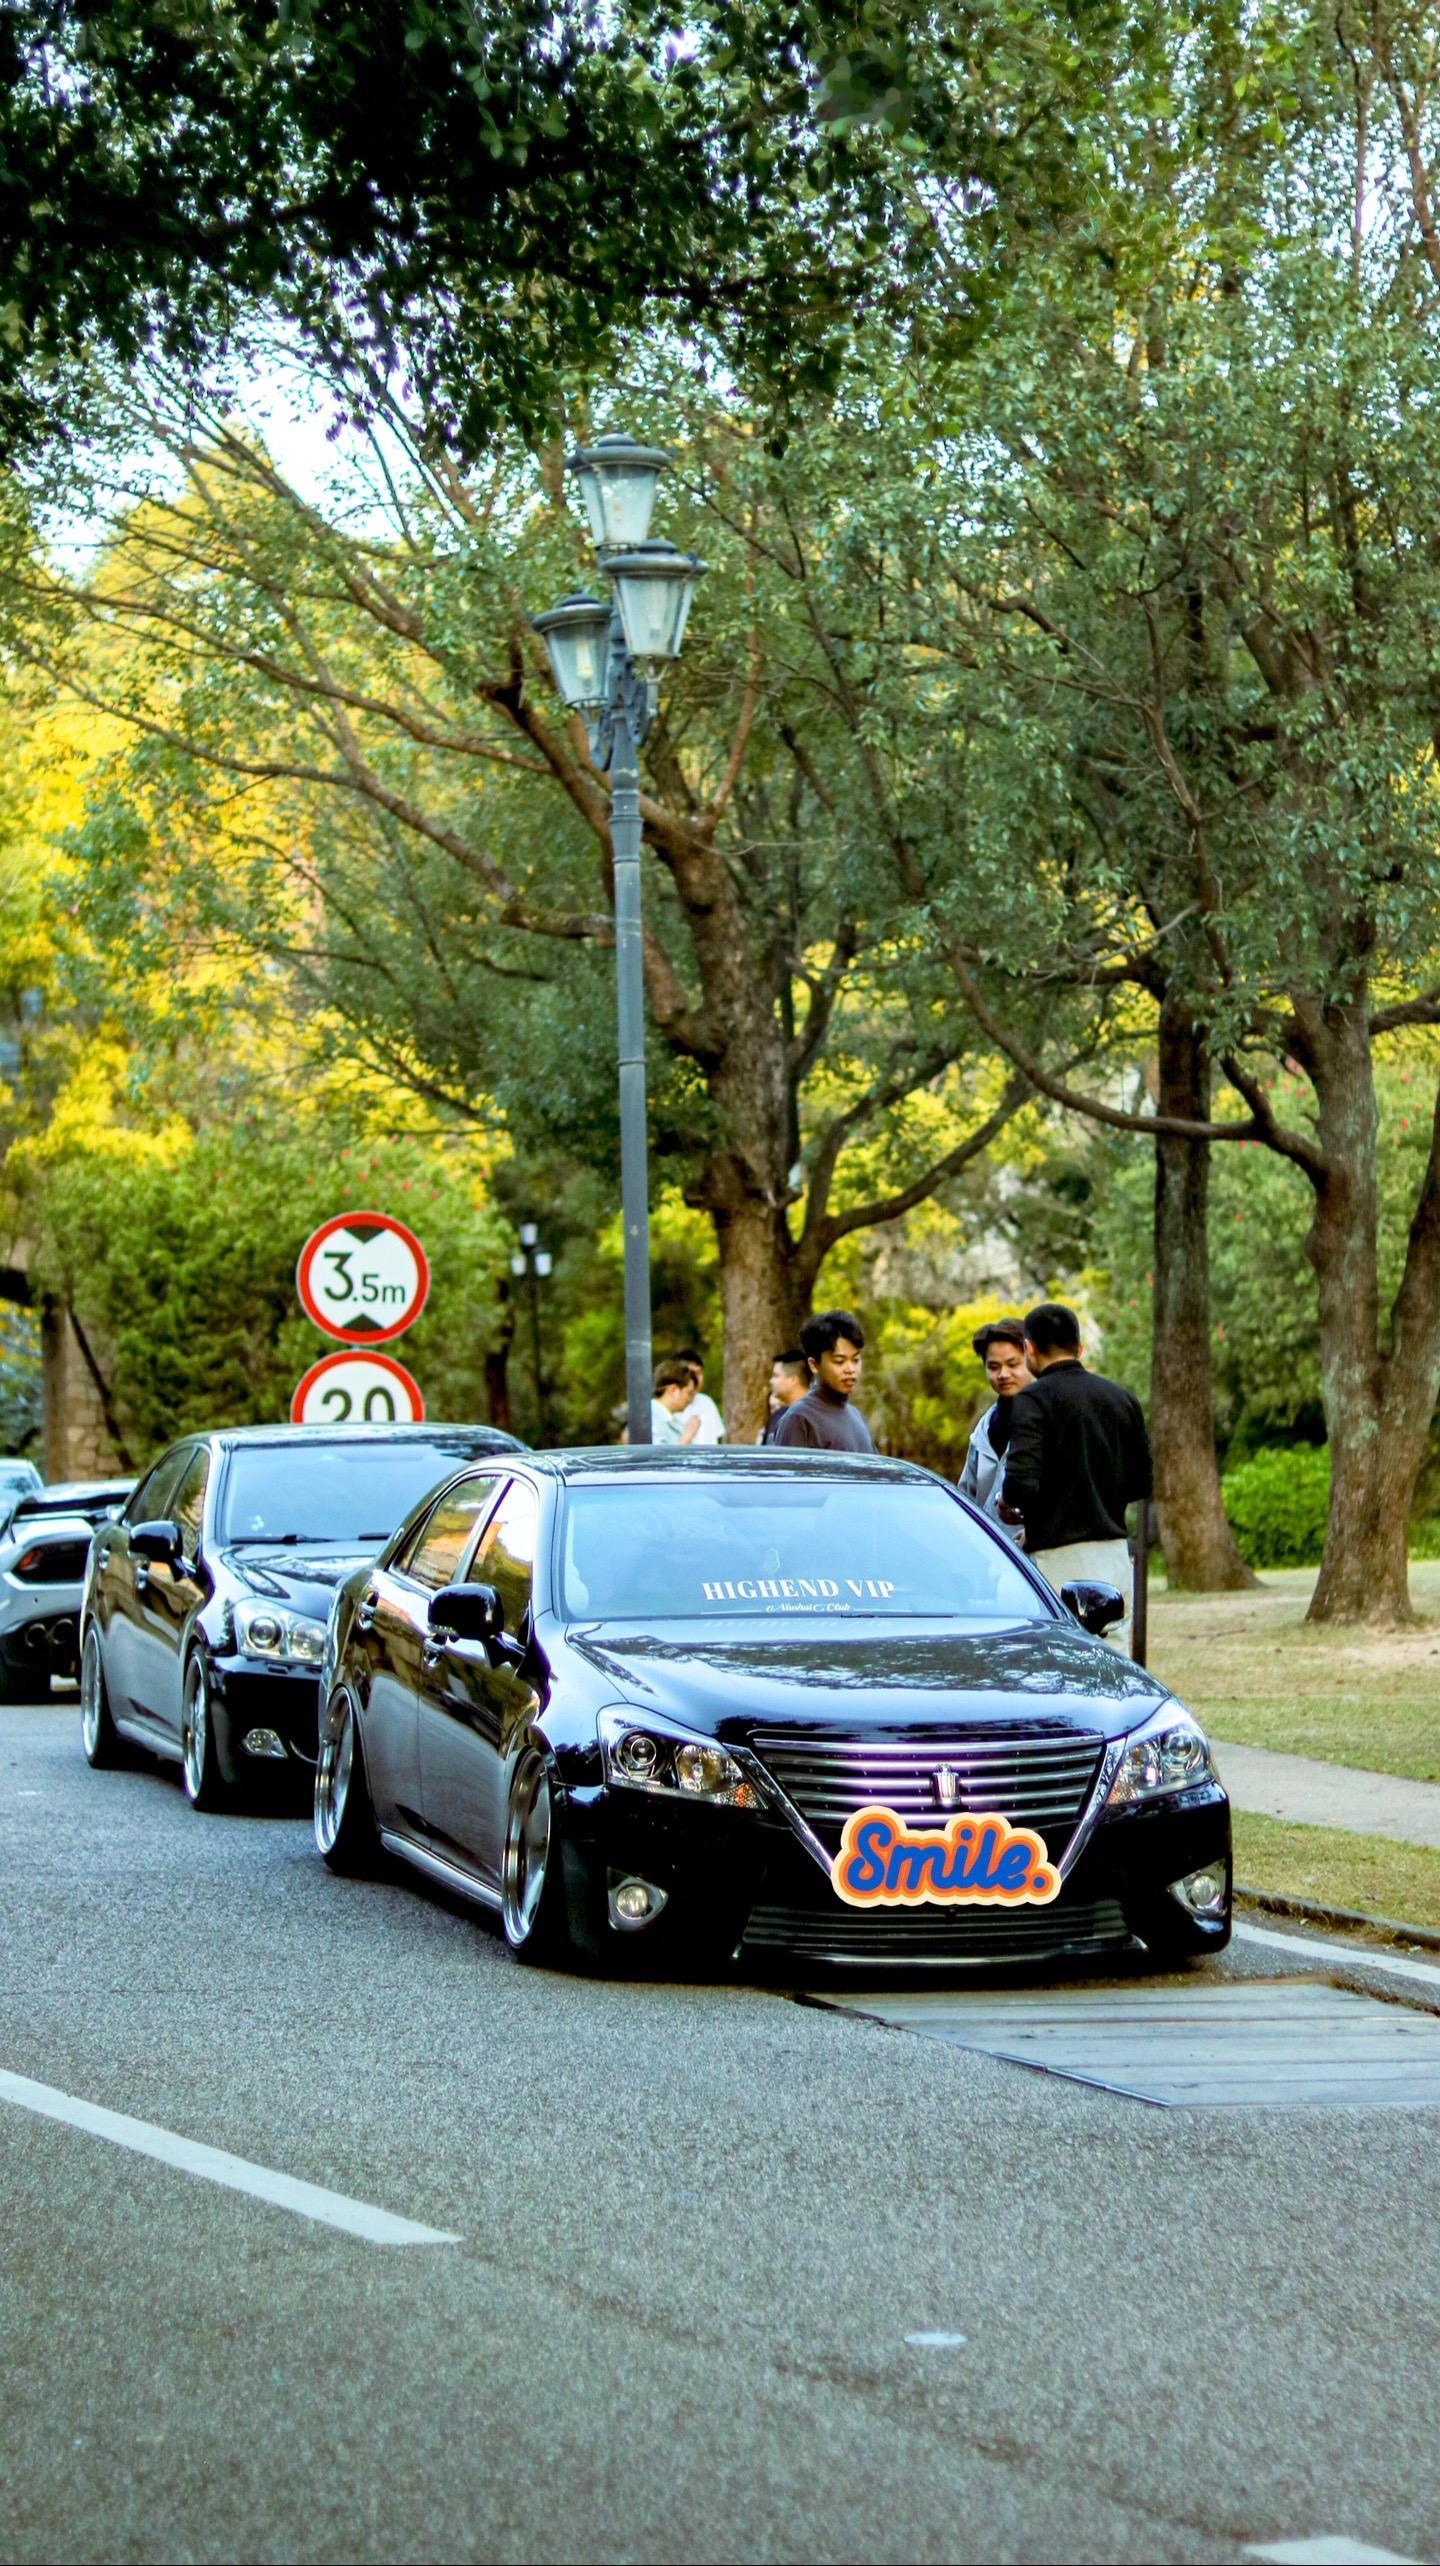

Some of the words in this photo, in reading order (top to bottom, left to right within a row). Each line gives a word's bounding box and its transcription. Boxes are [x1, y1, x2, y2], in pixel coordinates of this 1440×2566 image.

[323, 1251, 406, 1304] 3.5m
[321, 1385, 396, 1423] 20
[701, 1578, 840, 1601] HIGHEND
[845, 1578, 896, 1601] VIP
[826, 1602, 850, 1612] Club
